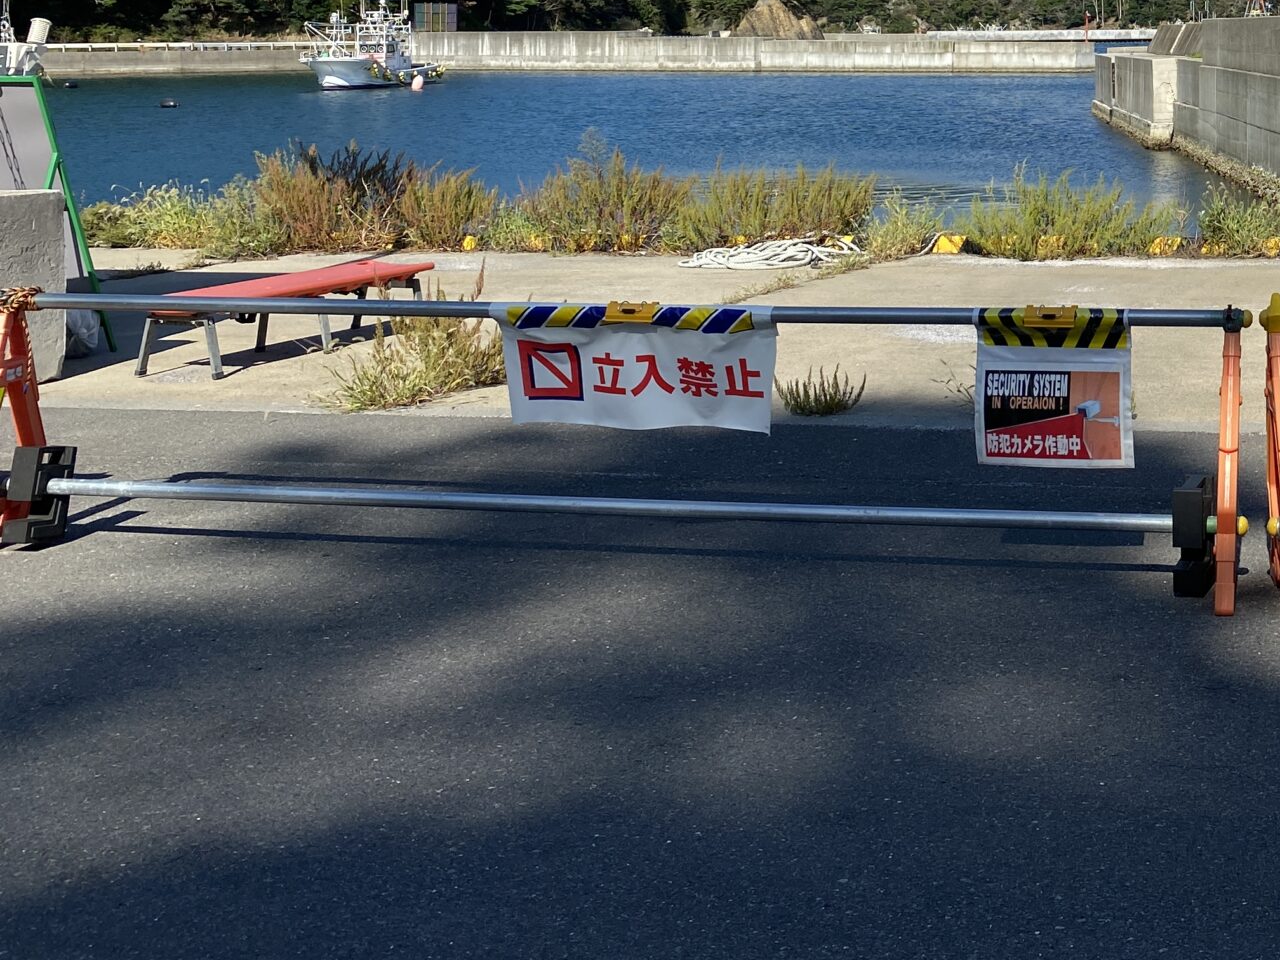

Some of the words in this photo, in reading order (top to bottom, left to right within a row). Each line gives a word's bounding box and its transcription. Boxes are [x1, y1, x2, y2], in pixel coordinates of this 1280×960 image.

[592, 352, 764, 398] 立入禁止
[987, 373, 1031, 396] SECURITY
[1033, 374, 1069, 397] SYSTEM
[992, 397, 1001, 409] IN
[987, 434, 1081, 456] 防犯カメラ作動中
